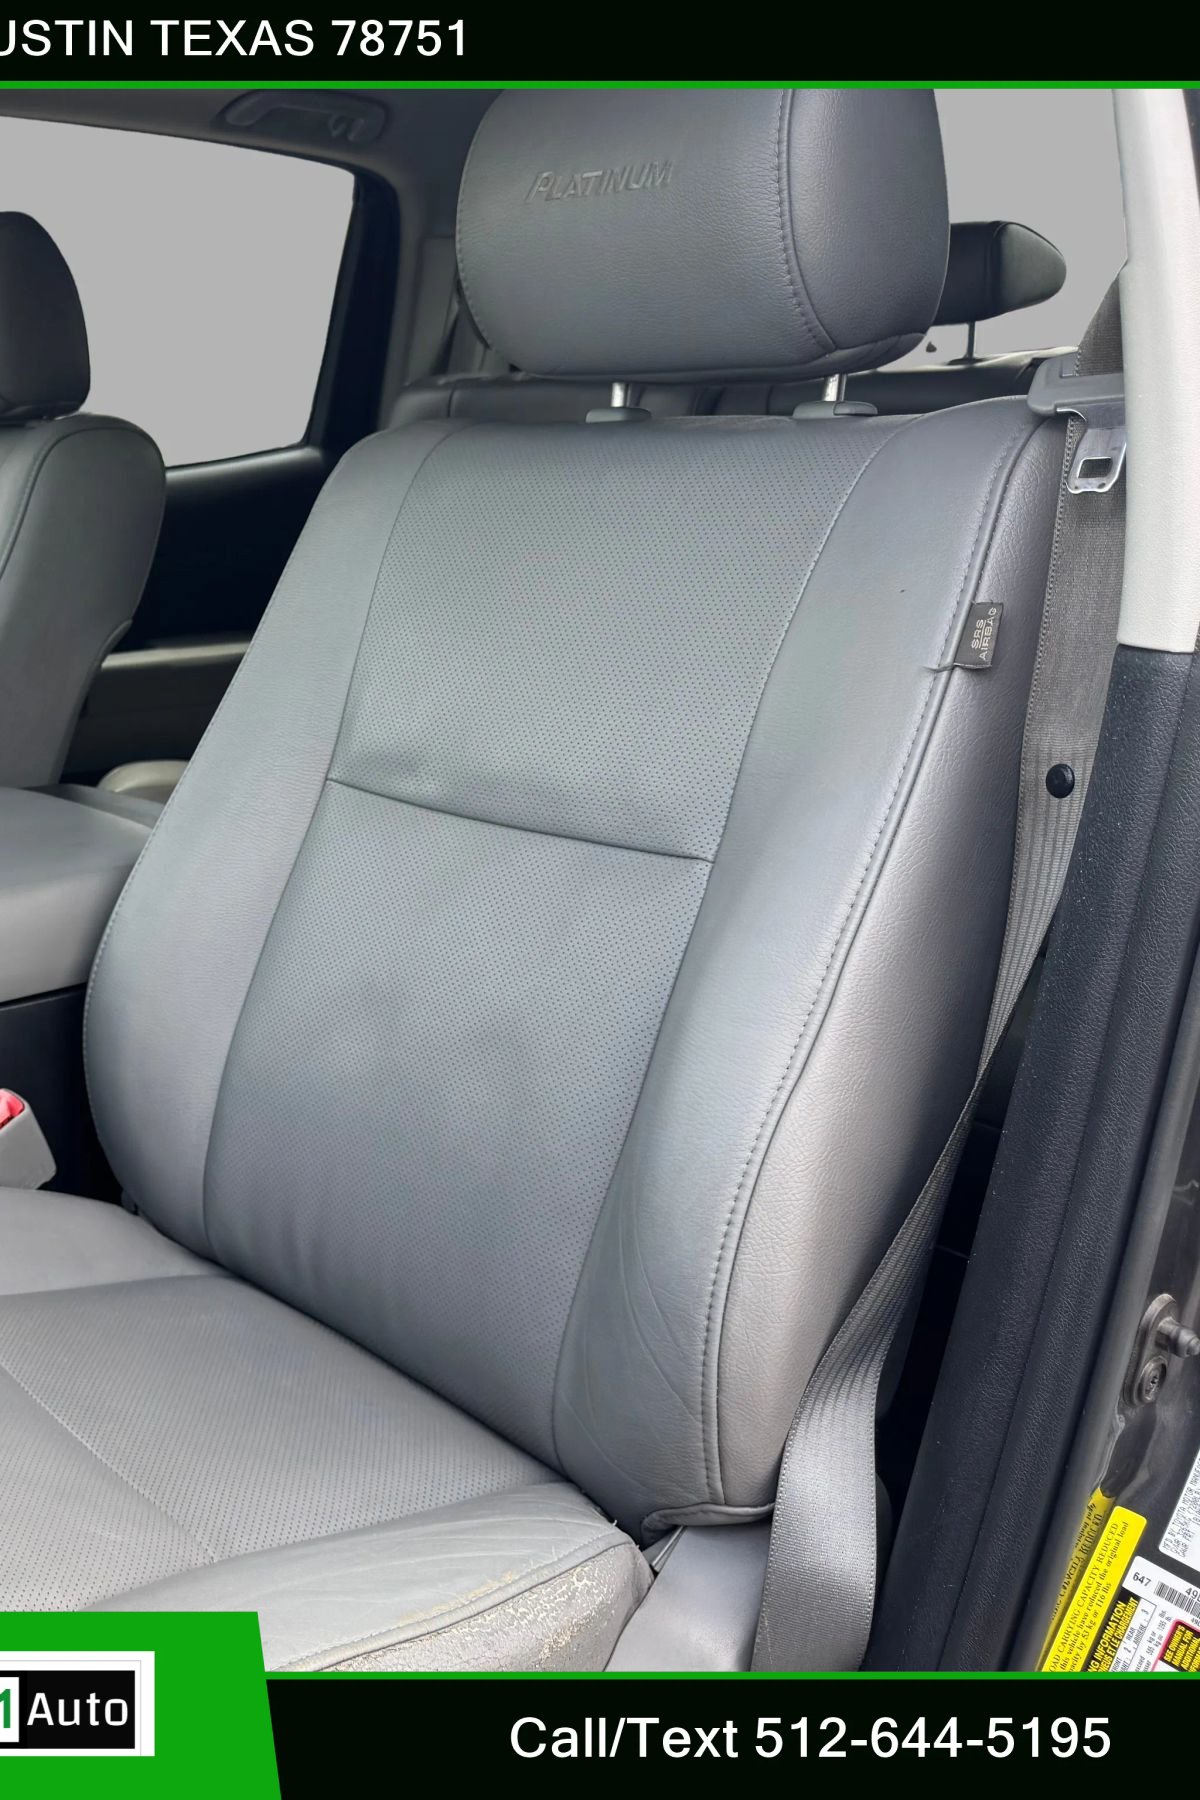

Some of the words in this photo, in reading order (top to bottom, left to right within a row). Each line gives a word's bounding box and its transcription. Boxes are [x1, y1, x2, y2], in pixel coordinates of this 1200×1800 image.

[526, 159, 674, 202] PLATINUM
[970, 618, 985, 649] SRS
[978, 607, 998, 661] AIRBAG
[1101, 1581, 1111, 1593] lbs
[1132, 1571, 1152, 1587] 647
[1055, 1608, 1082, 1653] CARRYING
[1075, 1565, 1101, 1608] CAPACITY
[1095, 1522, 1119, 1563] REDUCED
[1065, 1629, 1082, 1655] vehicle
[1076, 1610, 1090, 1629] have
[1083, 1581, 1103, 1611] reduced
[1097, 1567, 1108, 1580] the
[1104, 1538, 1123, 1568] original
[1117, 1521, 1129, 1537] load
[1094, 1594, 1106, 1607] 116
[1091, 1609, 1099, 1618] or
[1113, 1596, 1140, 1640] CHARGEMENT
[1085, 1619, 1096, 1630] kg
[1093, 1600, 1128, 1660] INFORMATION
[1076, 1640, 1087, 1651] by
[1109, 1637, 1121, 1647] LE
[1171, 1642, 1188, 1666] MANUAL
[1182, 1629, 1194, 1643] FOR
[1106, 1645, 1117, 1656] ET
[1163, 1649, 1174, 1662] SEE
